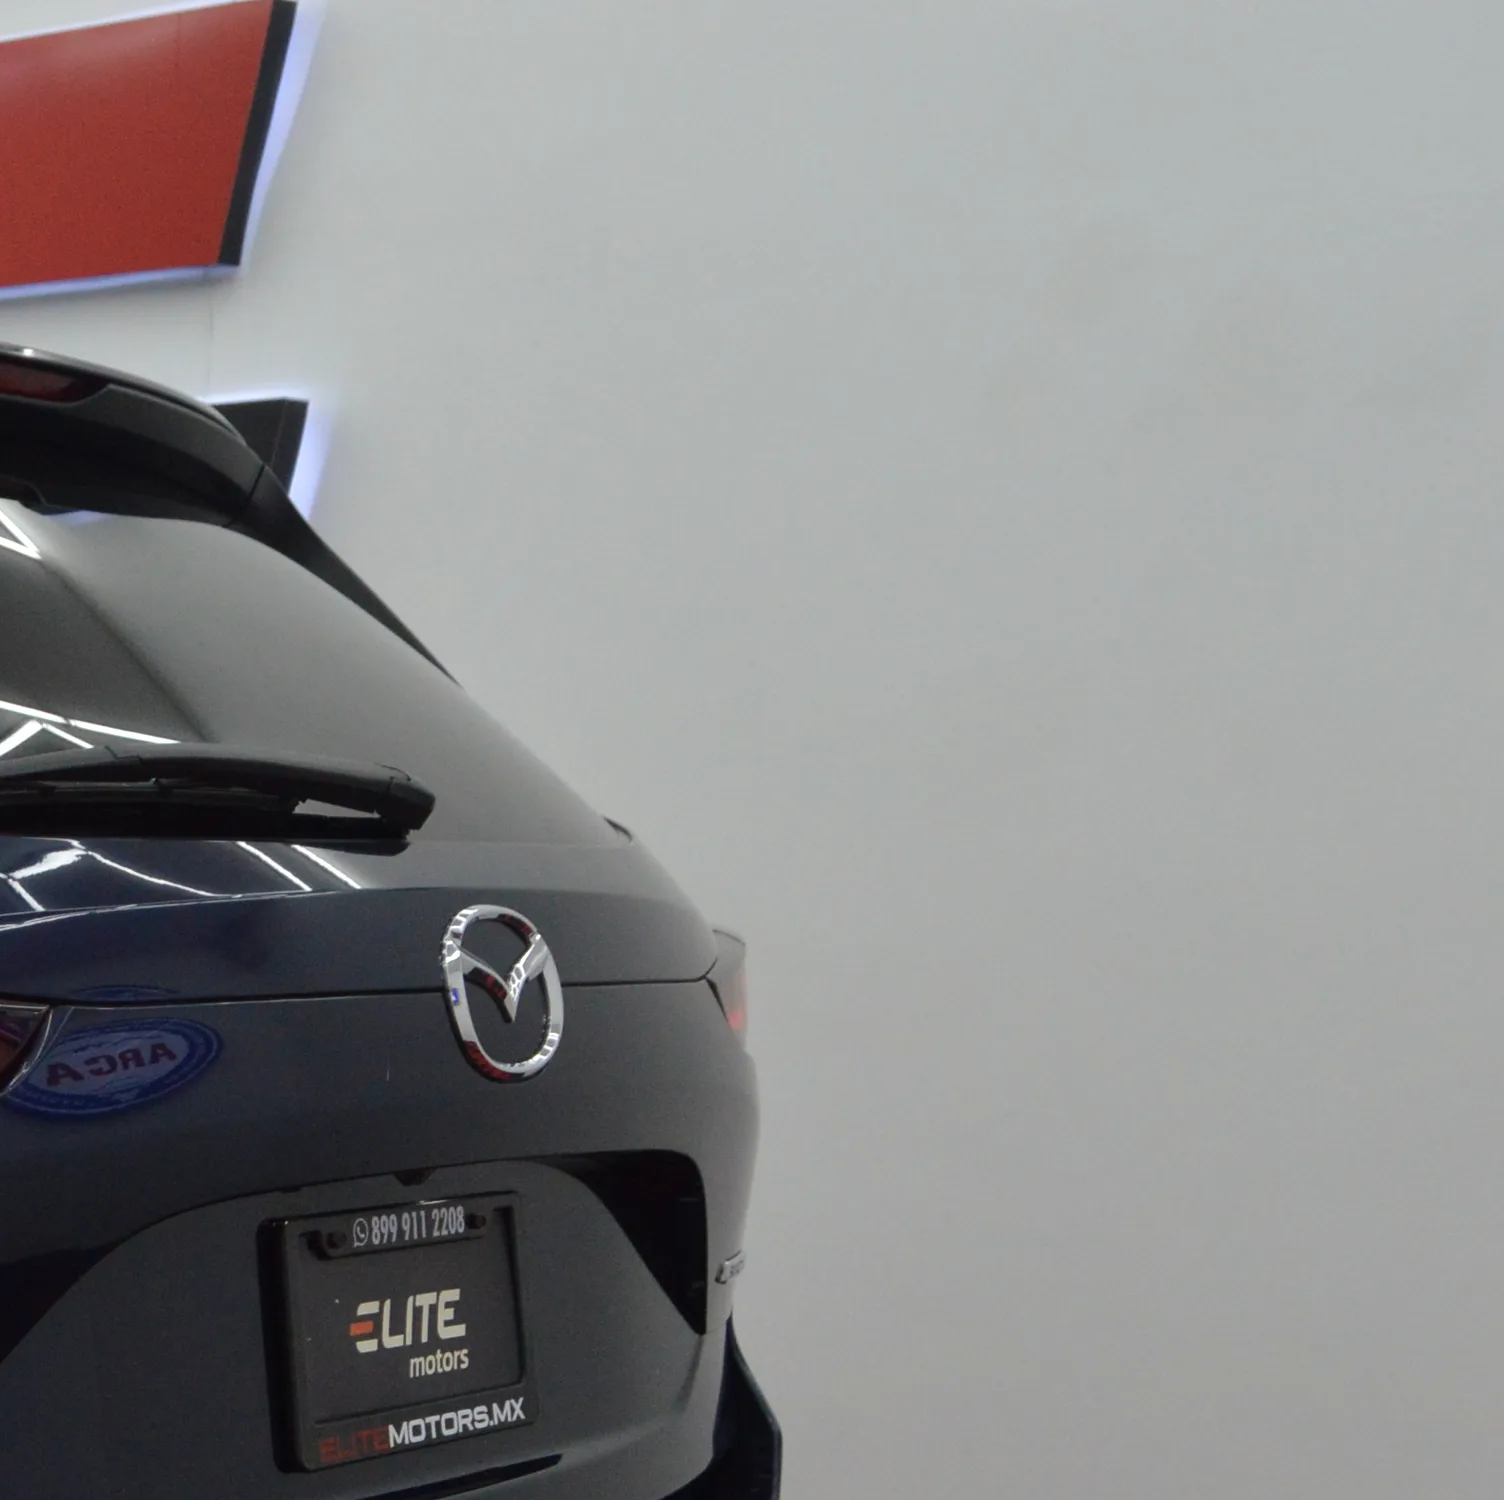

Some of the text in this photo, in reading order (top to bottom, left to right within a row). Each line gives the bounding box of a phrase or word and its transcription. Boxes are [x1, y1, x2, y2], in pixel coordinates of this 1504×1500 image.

[370, 1205, 465, 1245] 899 911 2208
[349, 1288, 467, 1354] ELITE
[409, 1348, 469, 1379] motors
